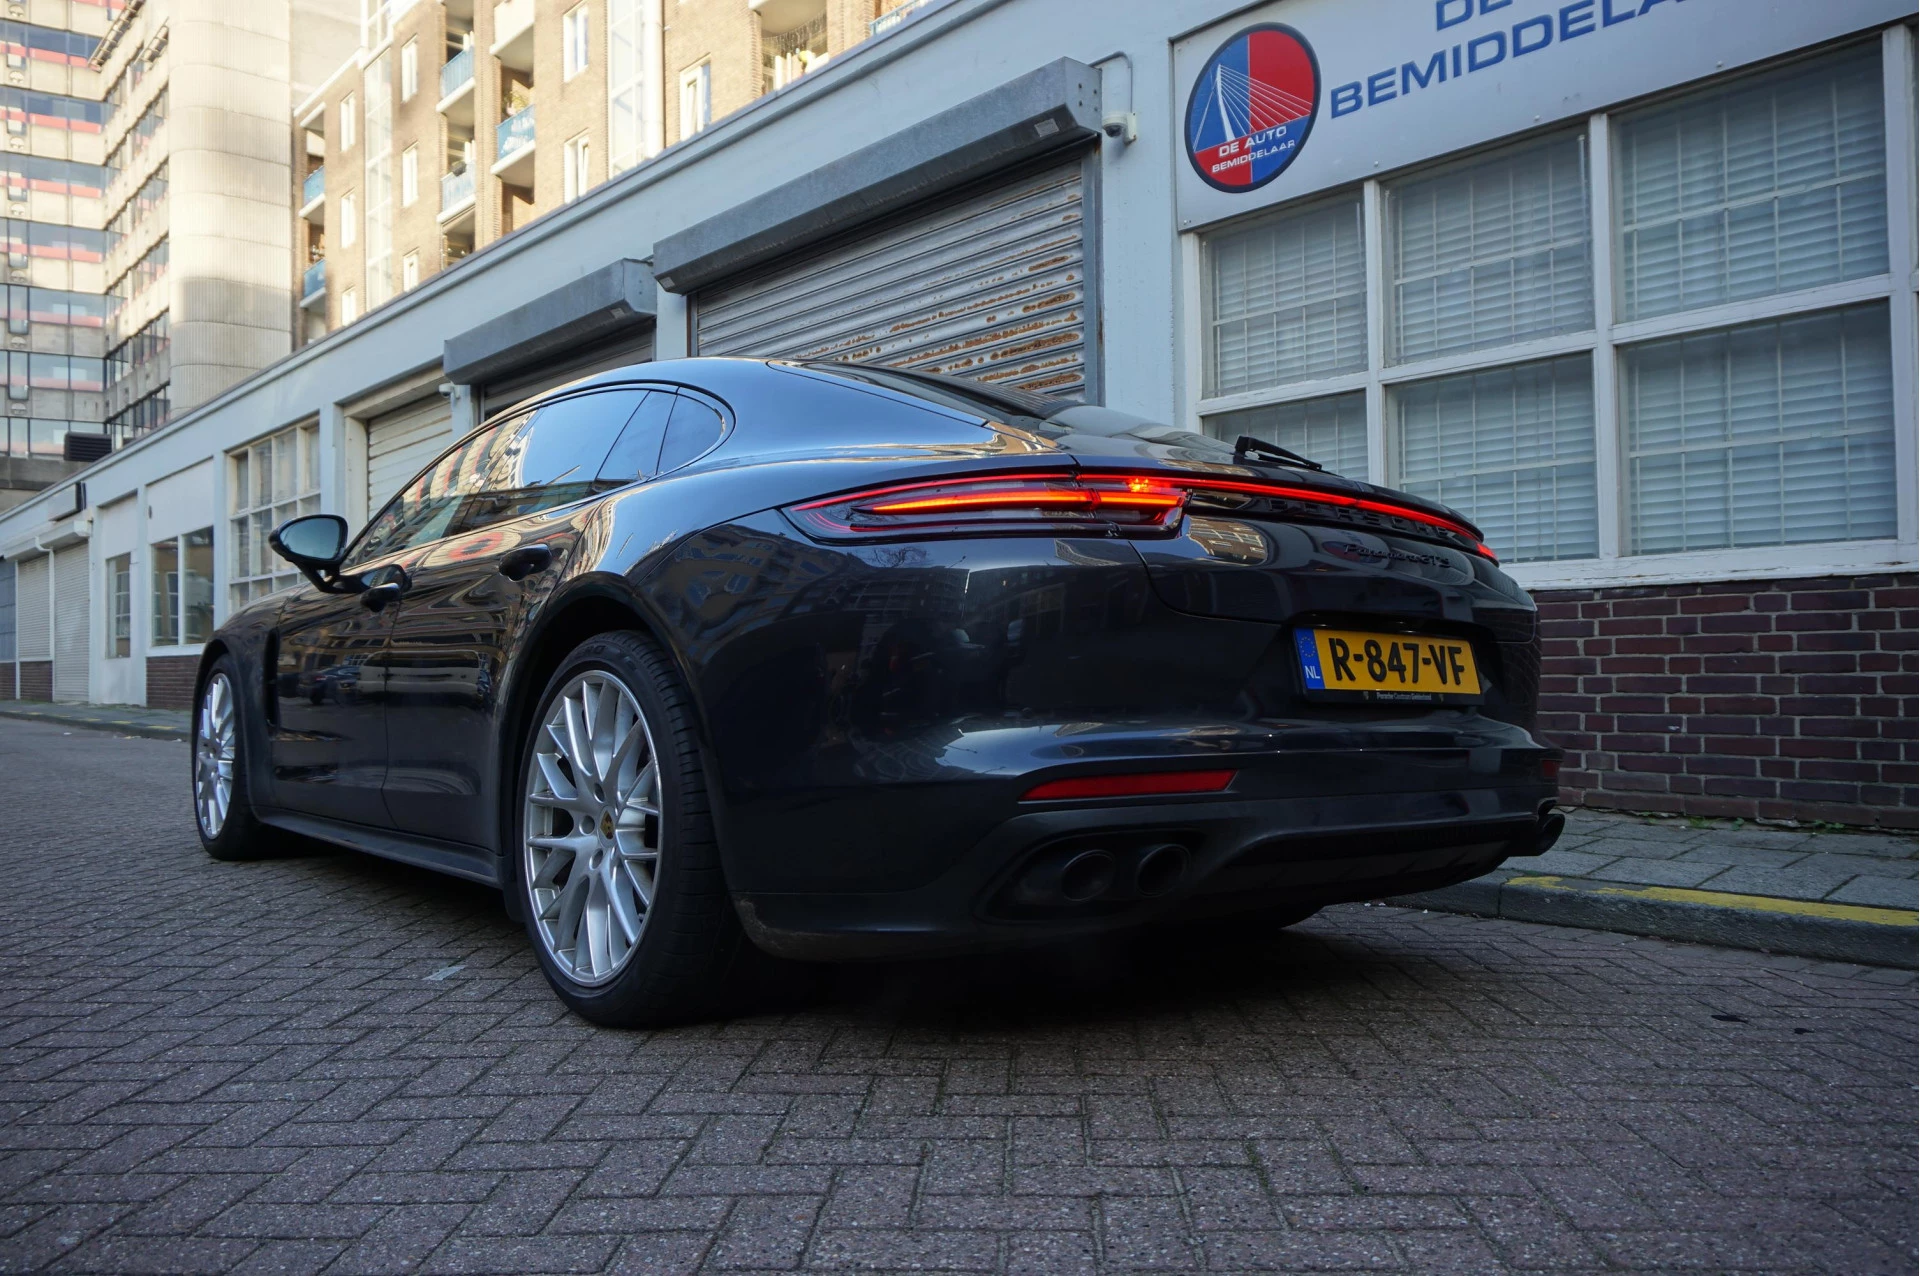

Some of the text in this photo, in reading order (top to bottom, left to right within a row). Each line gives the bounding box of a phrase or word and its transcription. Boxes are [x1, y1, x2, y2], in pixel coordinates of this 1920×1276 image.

[1331, 0, 1686, 119] BEMIDDEL
[1212, 139, 1296, 173] BEMIDDELAAR
[1219, 126, 1287, 157] DE AUTO
[1304, 665, 1321, 680] NL
[1328, 637, 1465, 686] R-847-VF
